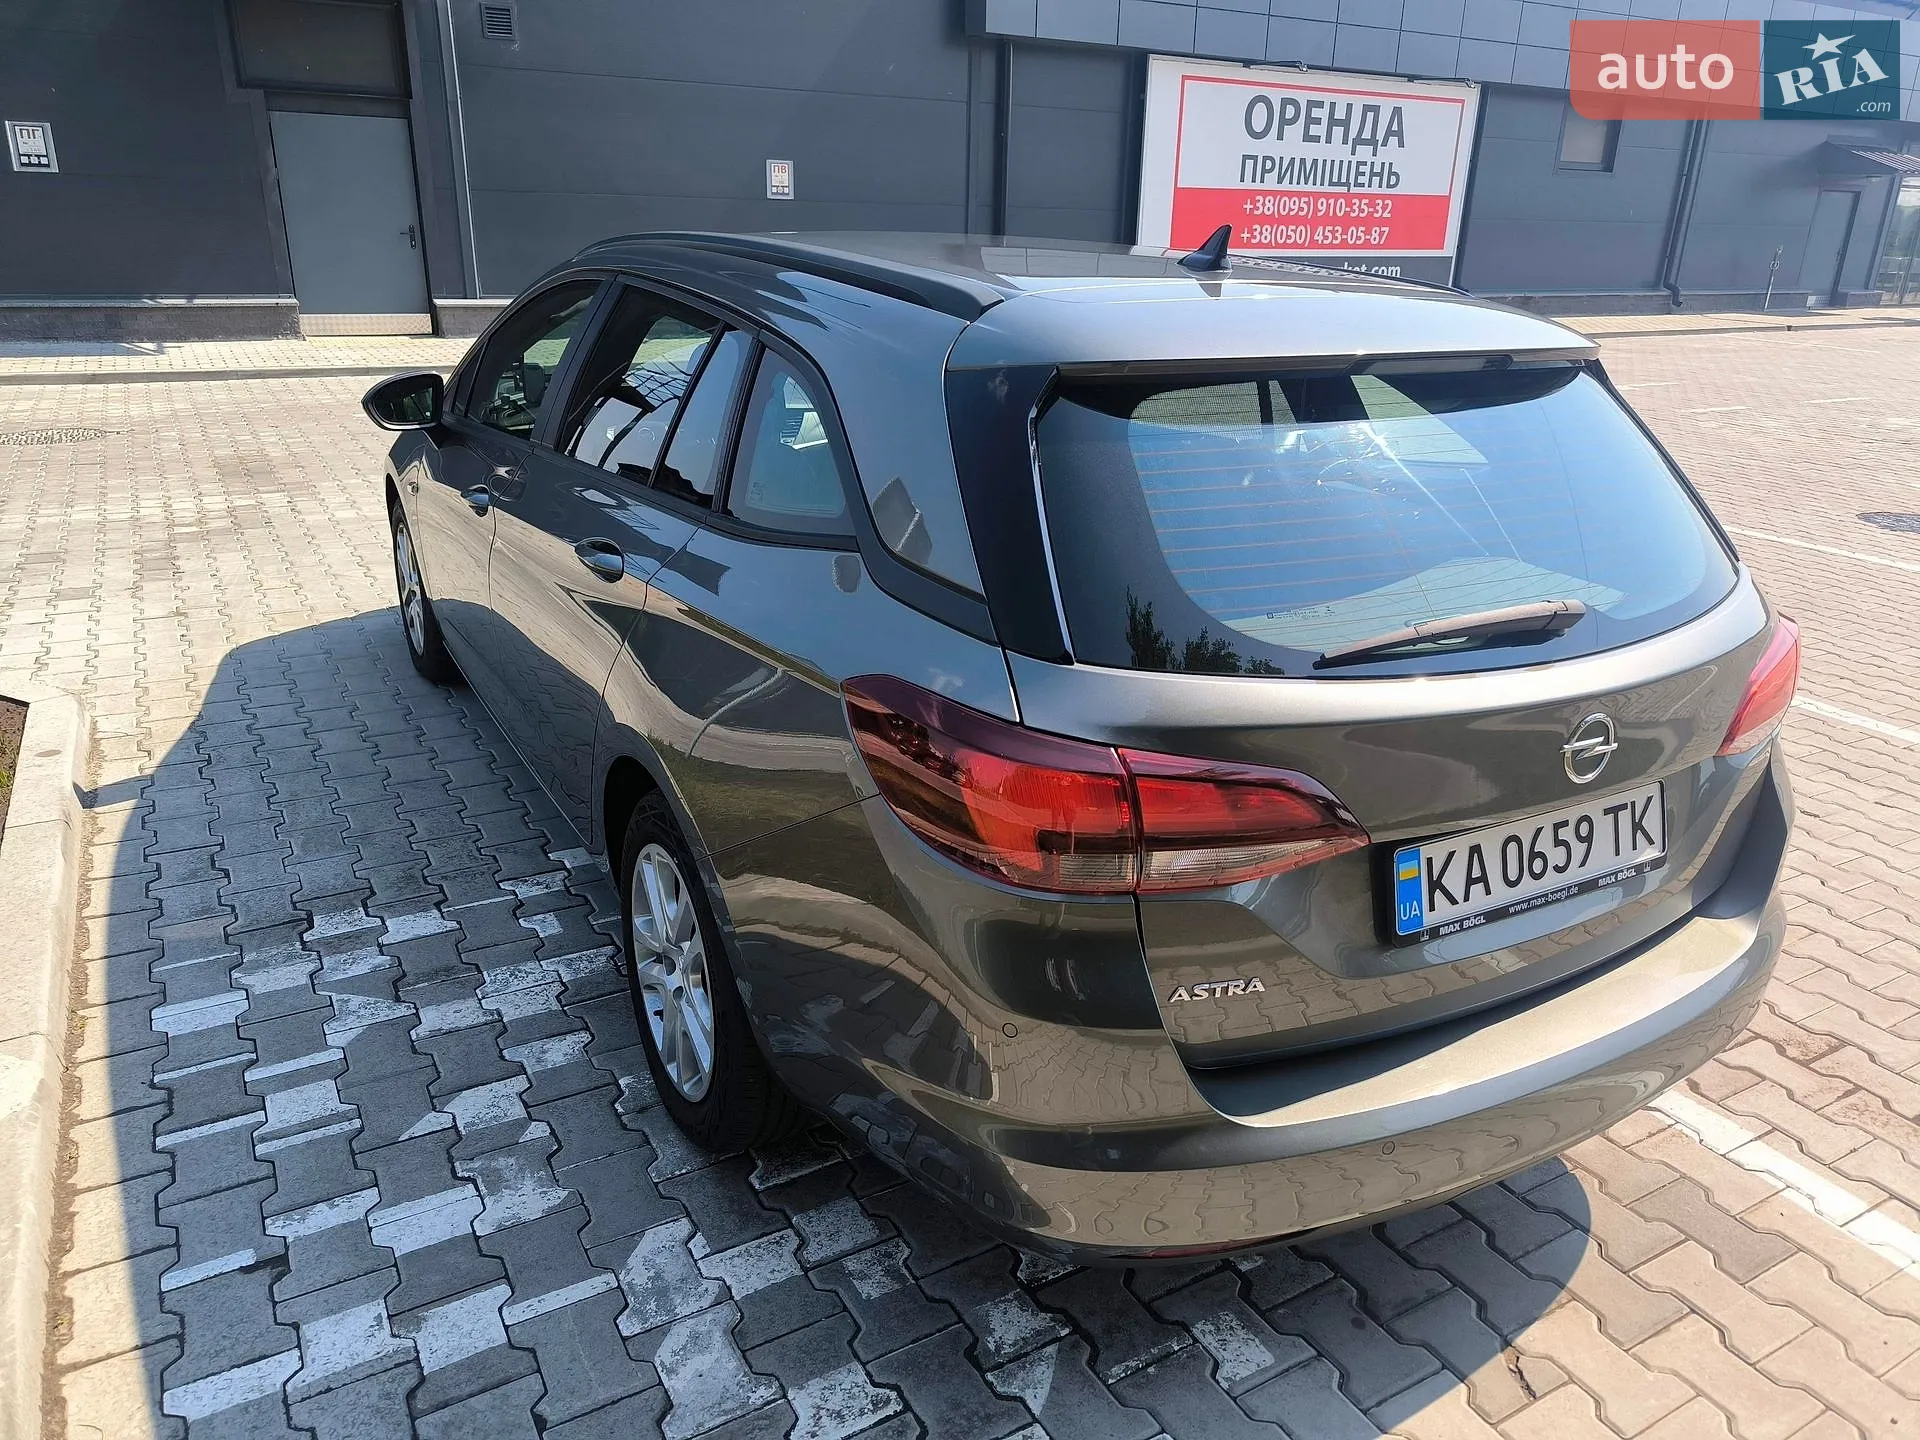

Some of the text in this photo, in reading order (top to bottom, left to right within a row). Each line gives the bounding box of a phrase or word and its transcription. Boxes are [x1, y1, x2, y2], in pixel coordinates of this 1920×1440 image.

[1244, 94, 1405, 157] ОРЕНДА
[1239, 154, 1401, 192] ПРИМІЩЕНЬ
[1242, 195, 1393, 219] +38(095) 910-35-32
[1240, 224, 1390, 247] +38(050) 453-05-87
[1425, 795, 1657, 913] KA 0659 TK
[1598, 867, 1637, 888] MAX BÖGL
[1400, 899, 1421, 921] UA
[1508, 884, 1579, 914] www.max-boegl.de
[1439, 915, 1486, 936] MAX BÖGL
[1168, 976, 1266, 1003] ASTRA
